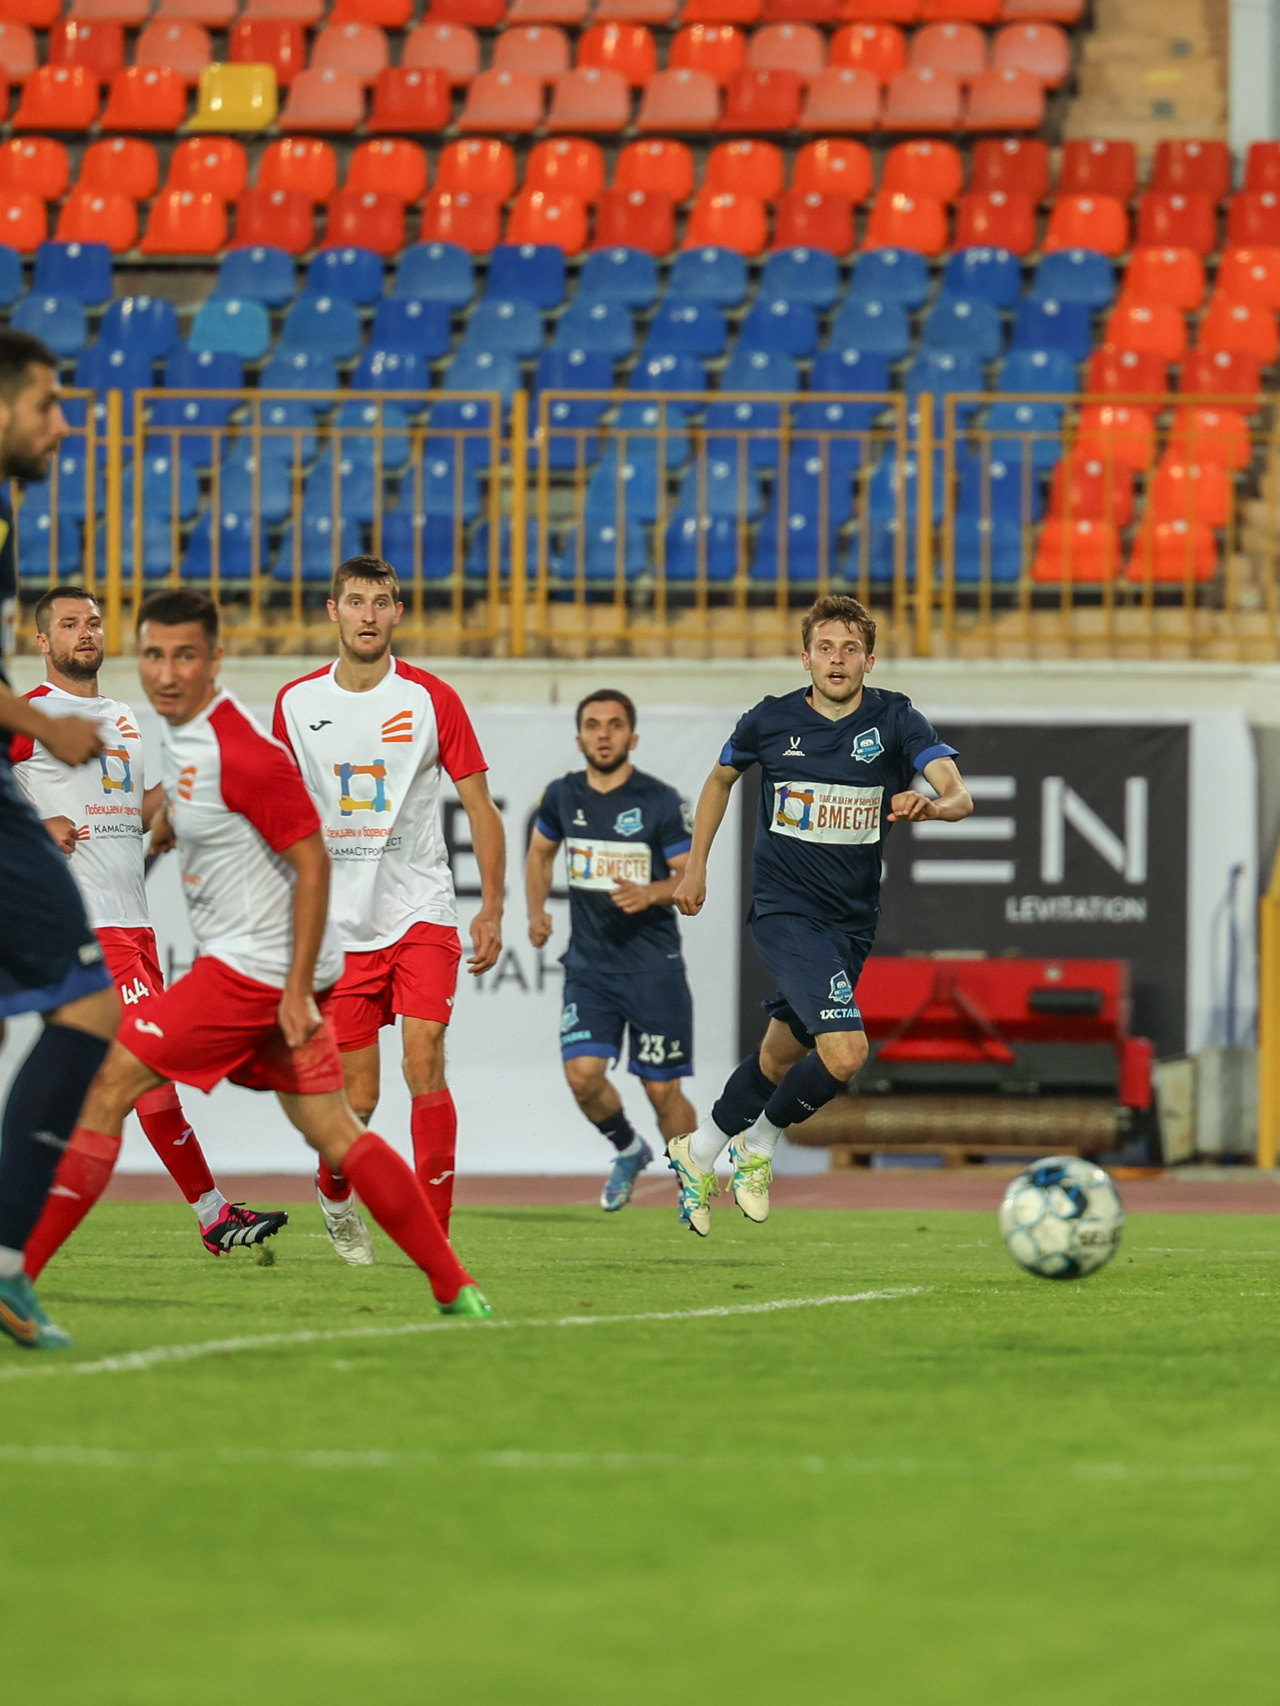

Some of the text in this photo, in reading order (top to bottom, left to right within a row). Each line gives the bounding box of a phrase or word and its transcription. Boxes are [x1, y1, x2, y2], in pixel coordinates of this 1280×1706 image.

[817, 804, 879, 830] ВМЕСТЕ
[597, 859, 648, 878] ВМЕСТЕ
[1006, 896, 1147, 923] LEVITATION
[121, 977, 150, 1005] 44
[638, 1032, 665, 1065] 23
